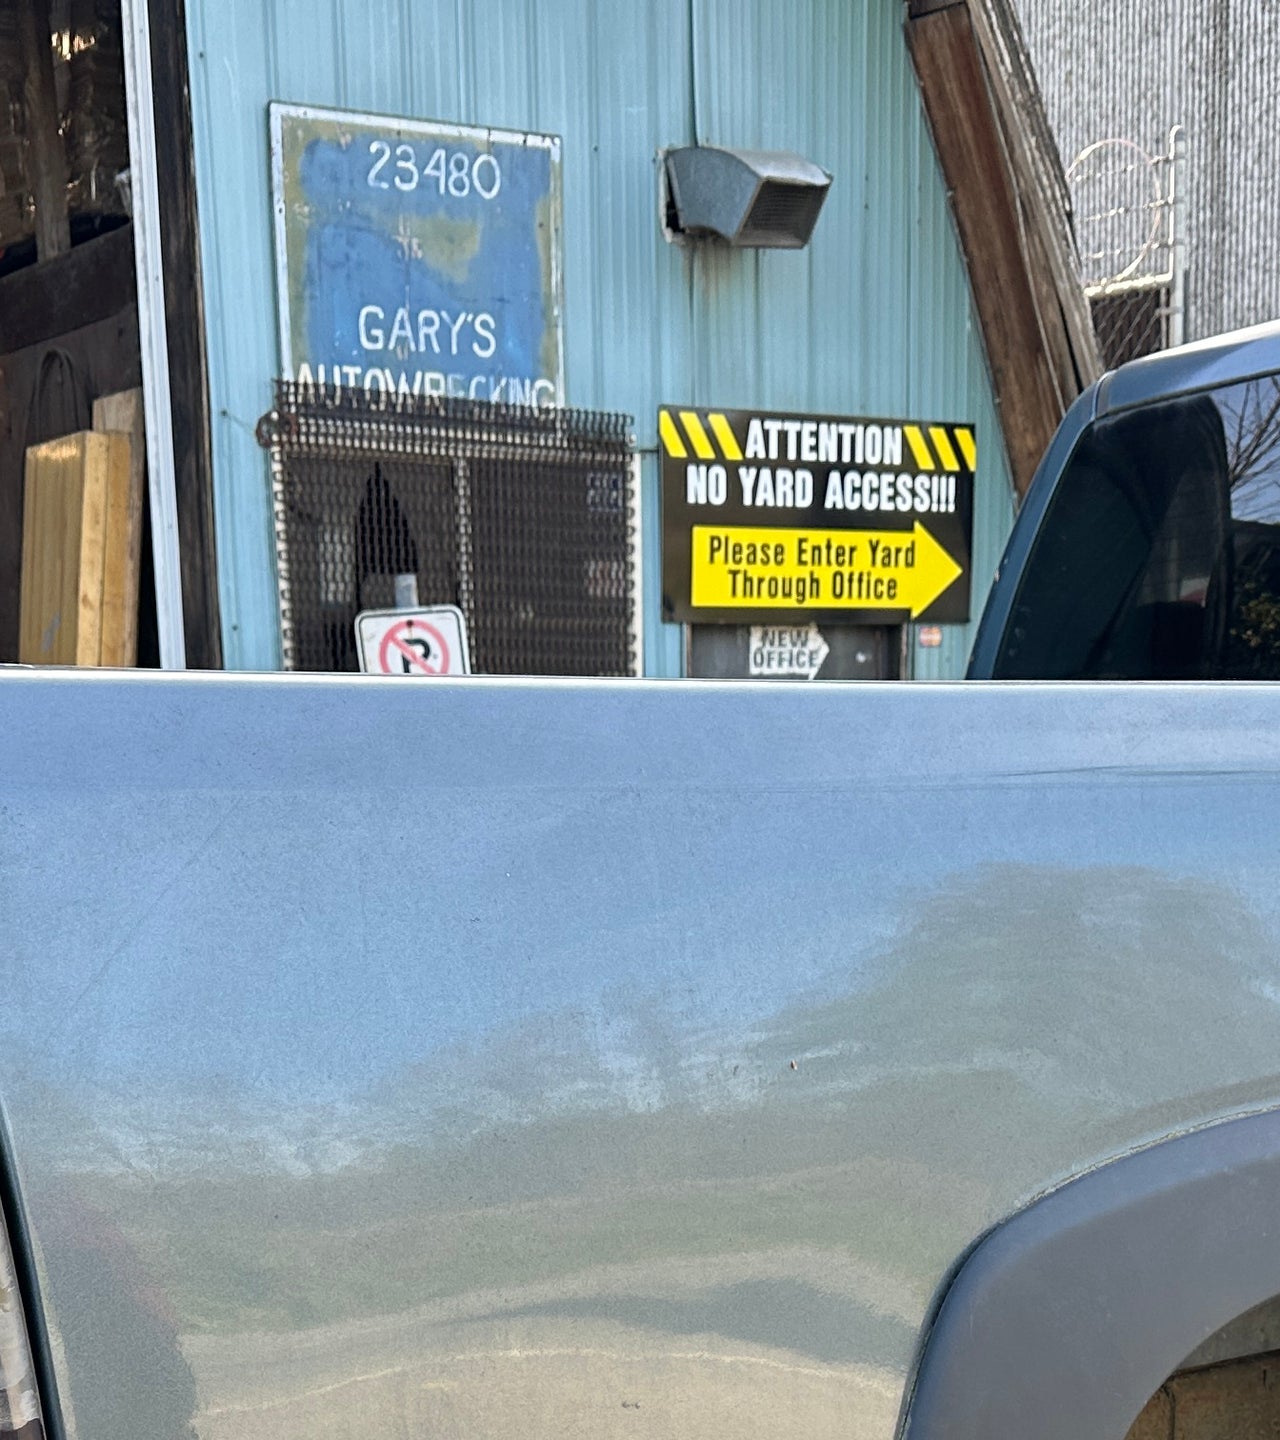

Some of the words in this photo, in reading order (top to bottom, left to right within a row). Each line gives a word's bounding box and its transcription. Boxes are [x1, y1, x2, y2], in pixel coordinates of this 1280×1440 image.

[367, 140, 502, 200] 23480
[358, 304, 497, 359] GARY'S
[744, 417, 903, 466] ATTENTION
[685, 463, 728, 506] NO
[737, 466, 814, 509] YARD
[823, 470, 957, 513] ACCESS!!!
[708, 534, 785, 566] Please
[796, 537, 858, 568] Enter
[867, 538, 917, 569] Yard
[727, 569, 820, 605] Through
[832, 570, 898, 601] Office
[753, 650, 818, 668] OFFICE
[761, 628, 810, 648] NEW
